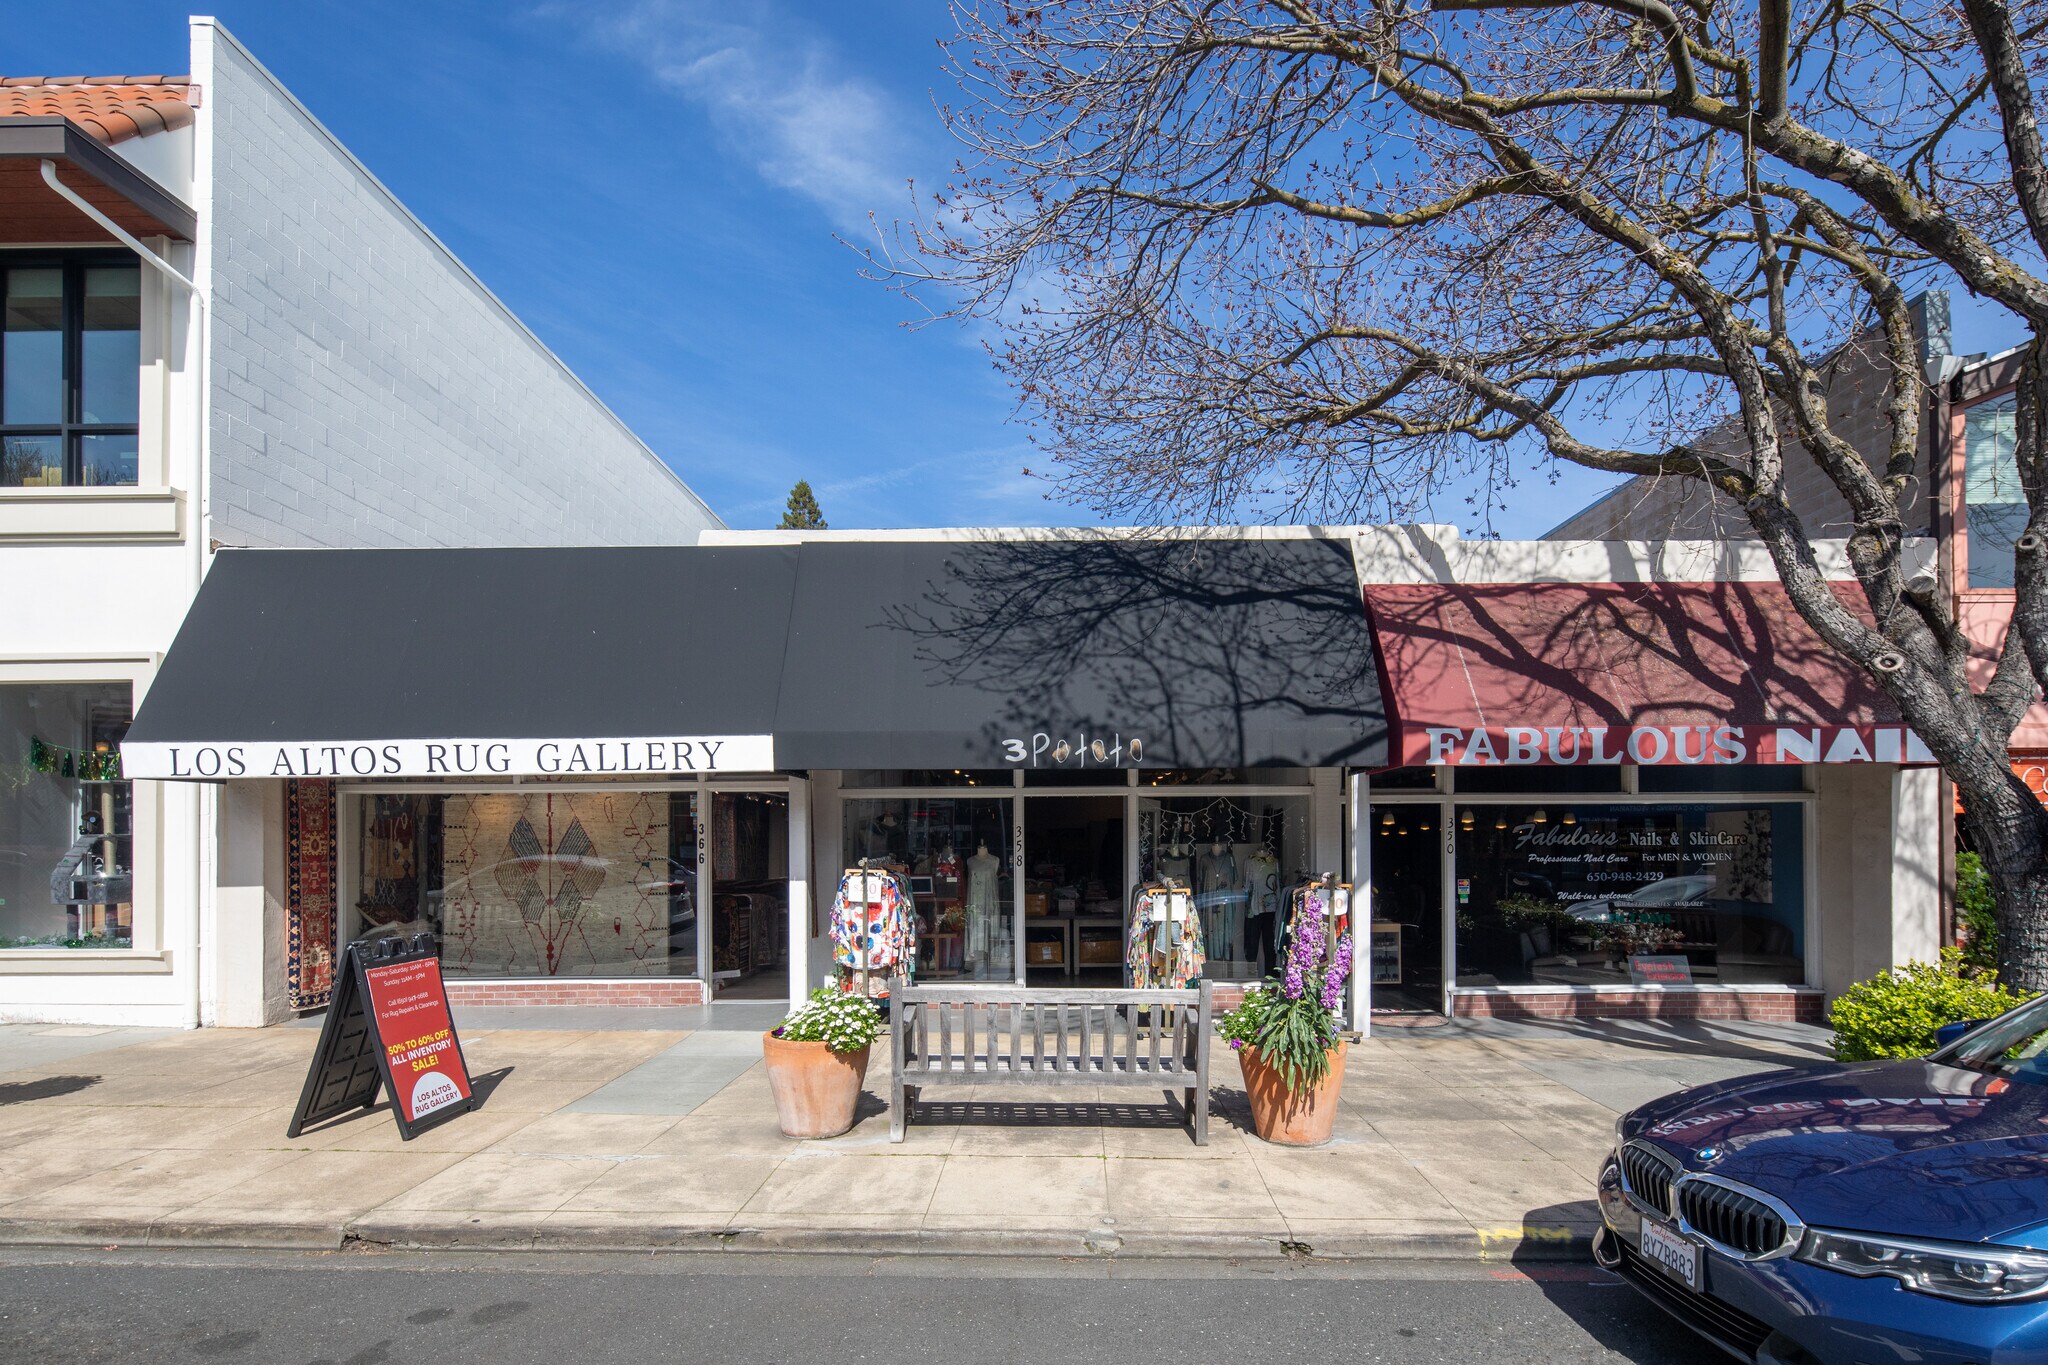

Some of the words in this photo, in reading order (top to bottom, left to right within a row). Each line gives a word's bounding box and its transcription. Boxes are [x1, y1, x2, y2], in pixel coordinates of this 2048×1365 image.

[1425, 726, 1747, 765] FABULOUS
[170, 747, 246, 776] LOS
[270, 745, 402, 776] ALTOS
[425, 743, 511, 773] RUG
[536, 741, 724, 772] GALLERY
[1446, 817, 1454, 854] 350
[1512, 823, 1619, 849] Fabulous
[1629, 832, 1662, 846] Nails
[1669, 832, 1680, 846] &
[1690, 831, 1748, 846] SkinCare
[1528, 854, 1582, 863] Professional
[1583, 854, 1605, 863] Nail
[1606, 854, 1628, 863] Care
[1642, 853, 1656, 861] For
[1657, 853, 1681, 861] MEN
[1682, 853, 1691, 861] &
[1693, 853, 1732, 861] WOMEN
[1586, 871, 1664, 882] 650-948-2429
[1557, 891, 1597, 900] Walk-ins
[1599, 891, 1633, 900] welcome
[388, 1043, 406, 1056] 50%
[405, 1039, 417, 1050] TO
[418, 1034, 435, 1045] 60%
[434, 1028, 449, 1040] OFF
[392, 1056, 408, 1066] ALL
[407, 1039, 451, 1061] INVENTORY
[411, 1054, 439, 1073] SALE!
[415, 1102, 430, 1114] RUG
[429, 1090, 459, 1108] GALLERY
[417, 1091, 431, 1103] LOS
[431, 1083, 451, 1096] ALTOS
